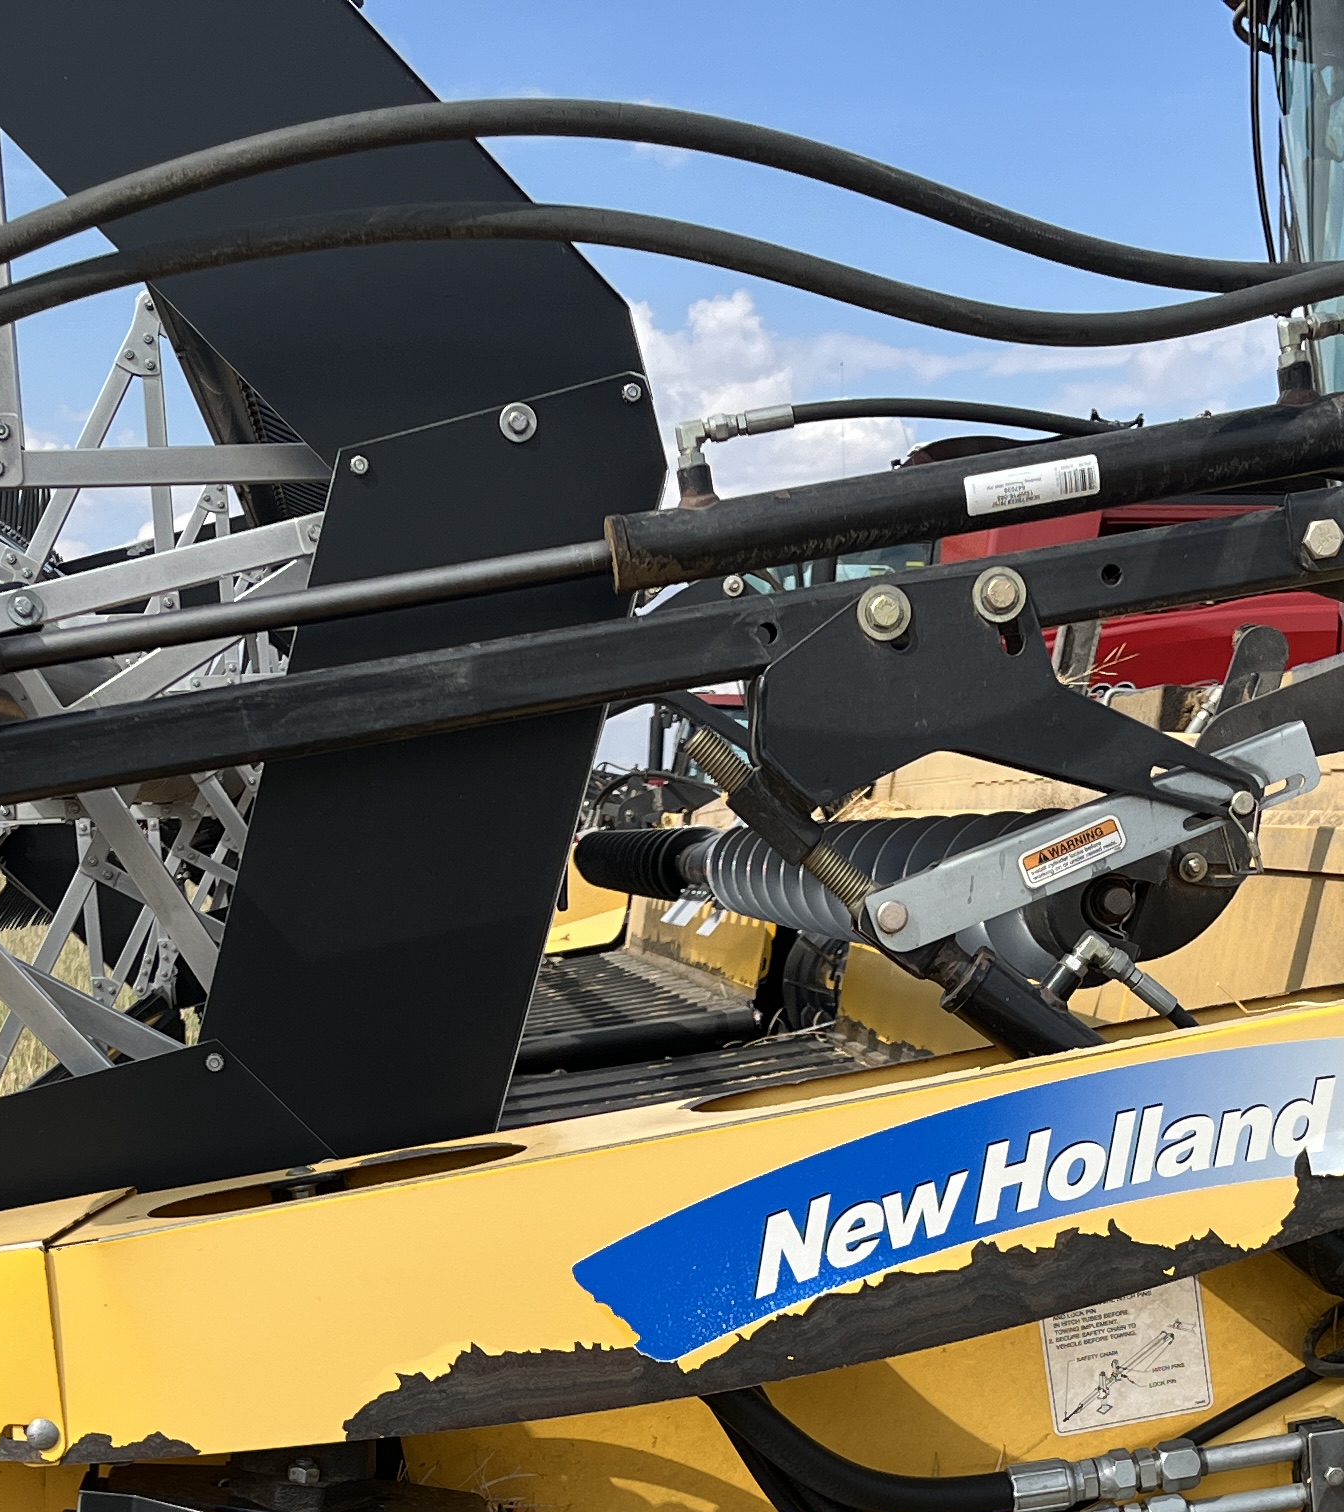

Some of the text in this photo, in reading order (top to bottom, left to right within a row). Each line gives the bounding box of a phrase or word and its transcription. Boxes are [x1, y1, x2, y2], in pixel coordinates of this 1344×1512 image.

[1048, 827, 1103, 858] WARNING
[755, 1074, 1337, 1300] New Holland
